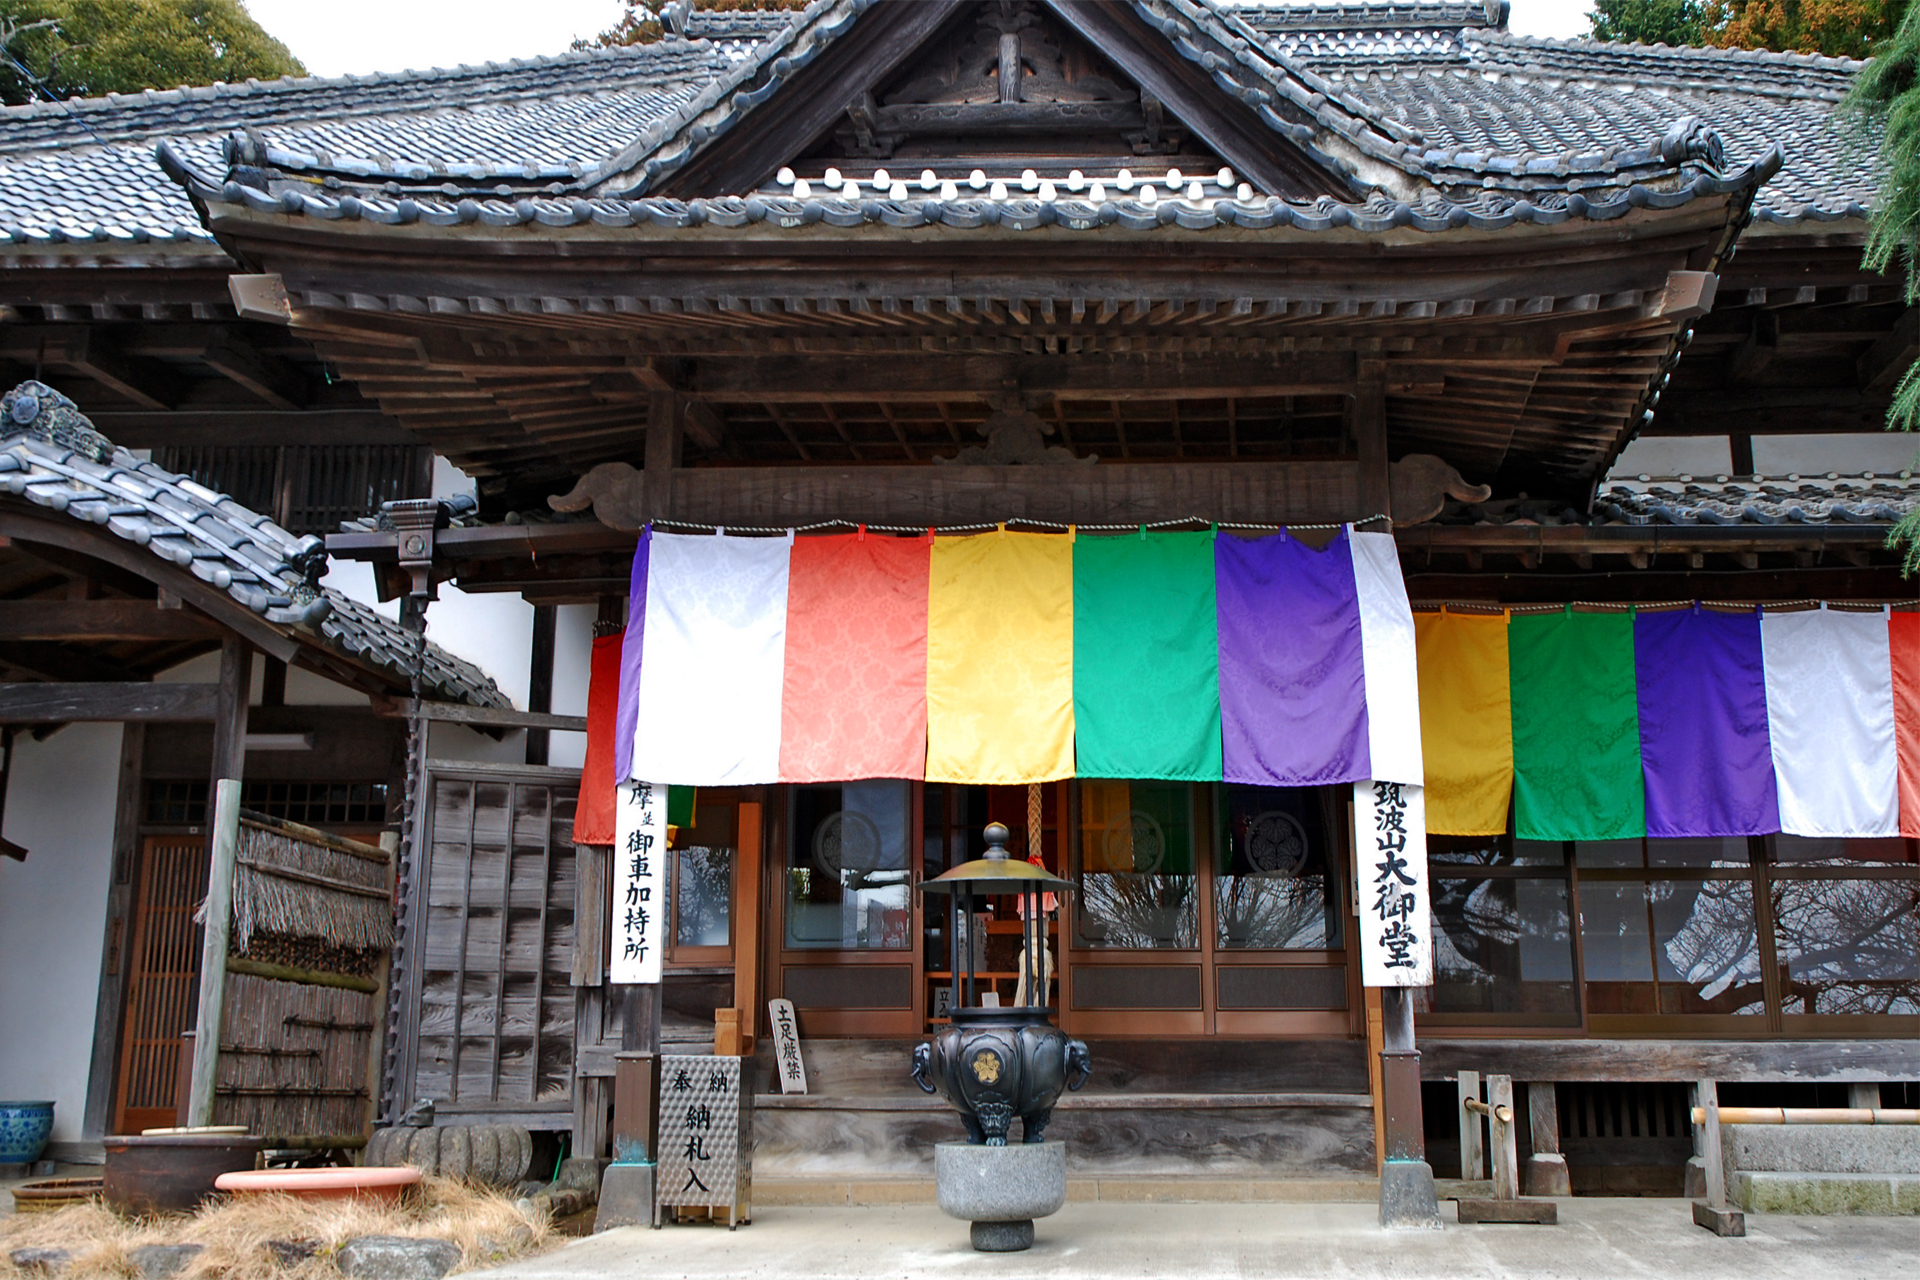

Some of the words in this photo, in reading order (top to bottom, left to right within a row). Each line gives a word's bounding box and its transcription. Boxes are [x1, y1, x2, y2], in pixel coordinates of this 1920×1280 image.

[623, 779, 655, 964] 摩並御車加持所
[1371, 781, 1417, 969] 筑波山大御堂
[777, 1005, 801, 1080] 土足厳禁
[682, 1104, 711, 1193] 納札入
